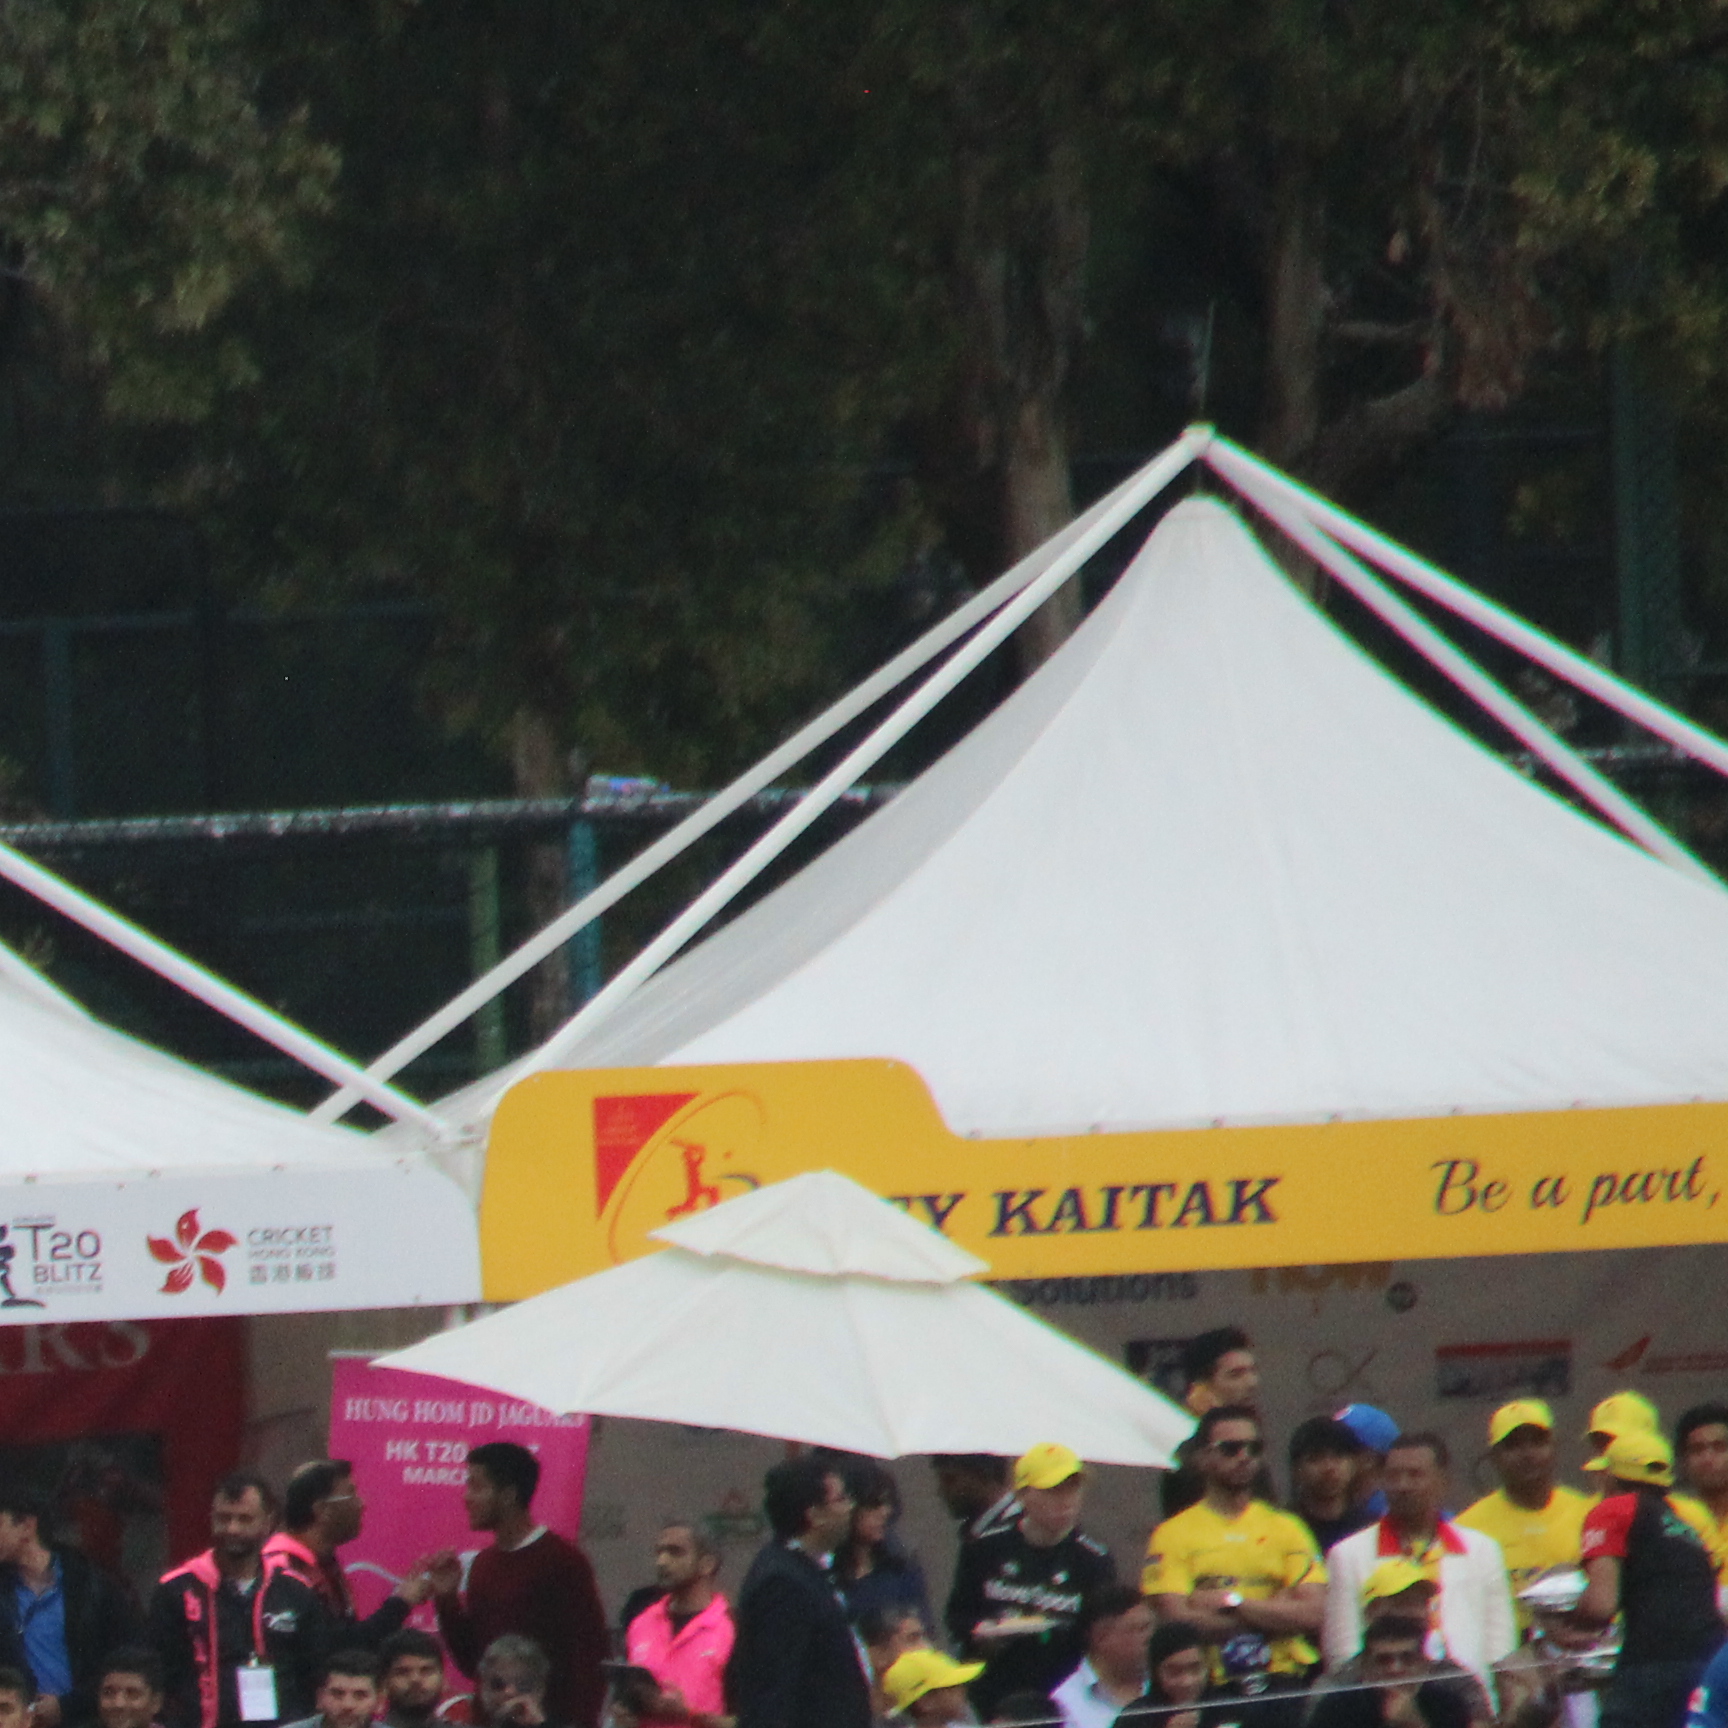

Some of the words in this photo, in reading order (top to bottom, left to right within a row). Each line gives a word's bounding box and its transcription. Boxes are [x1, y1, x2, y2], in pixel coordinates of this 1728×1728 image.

[1431, 1157, 1513, 1216] Be
[1529, 1173, 1570, 1209] a
[986, 1176, 1283, 1237] KAITAK
[13, 1222, 100, 1262] T20
[248, 1226, 334, 1246] CRICKET
[33, 1263, 103, 1284] BLITZ
[344, 1397, 410, 1422] HUNG
[413, 1400, 466, 1424] HOM
[469, 1401, 495, 1428] JD
[385, 1440, 420, 1462] HK
[424, 1442, 470, 1464] T20
